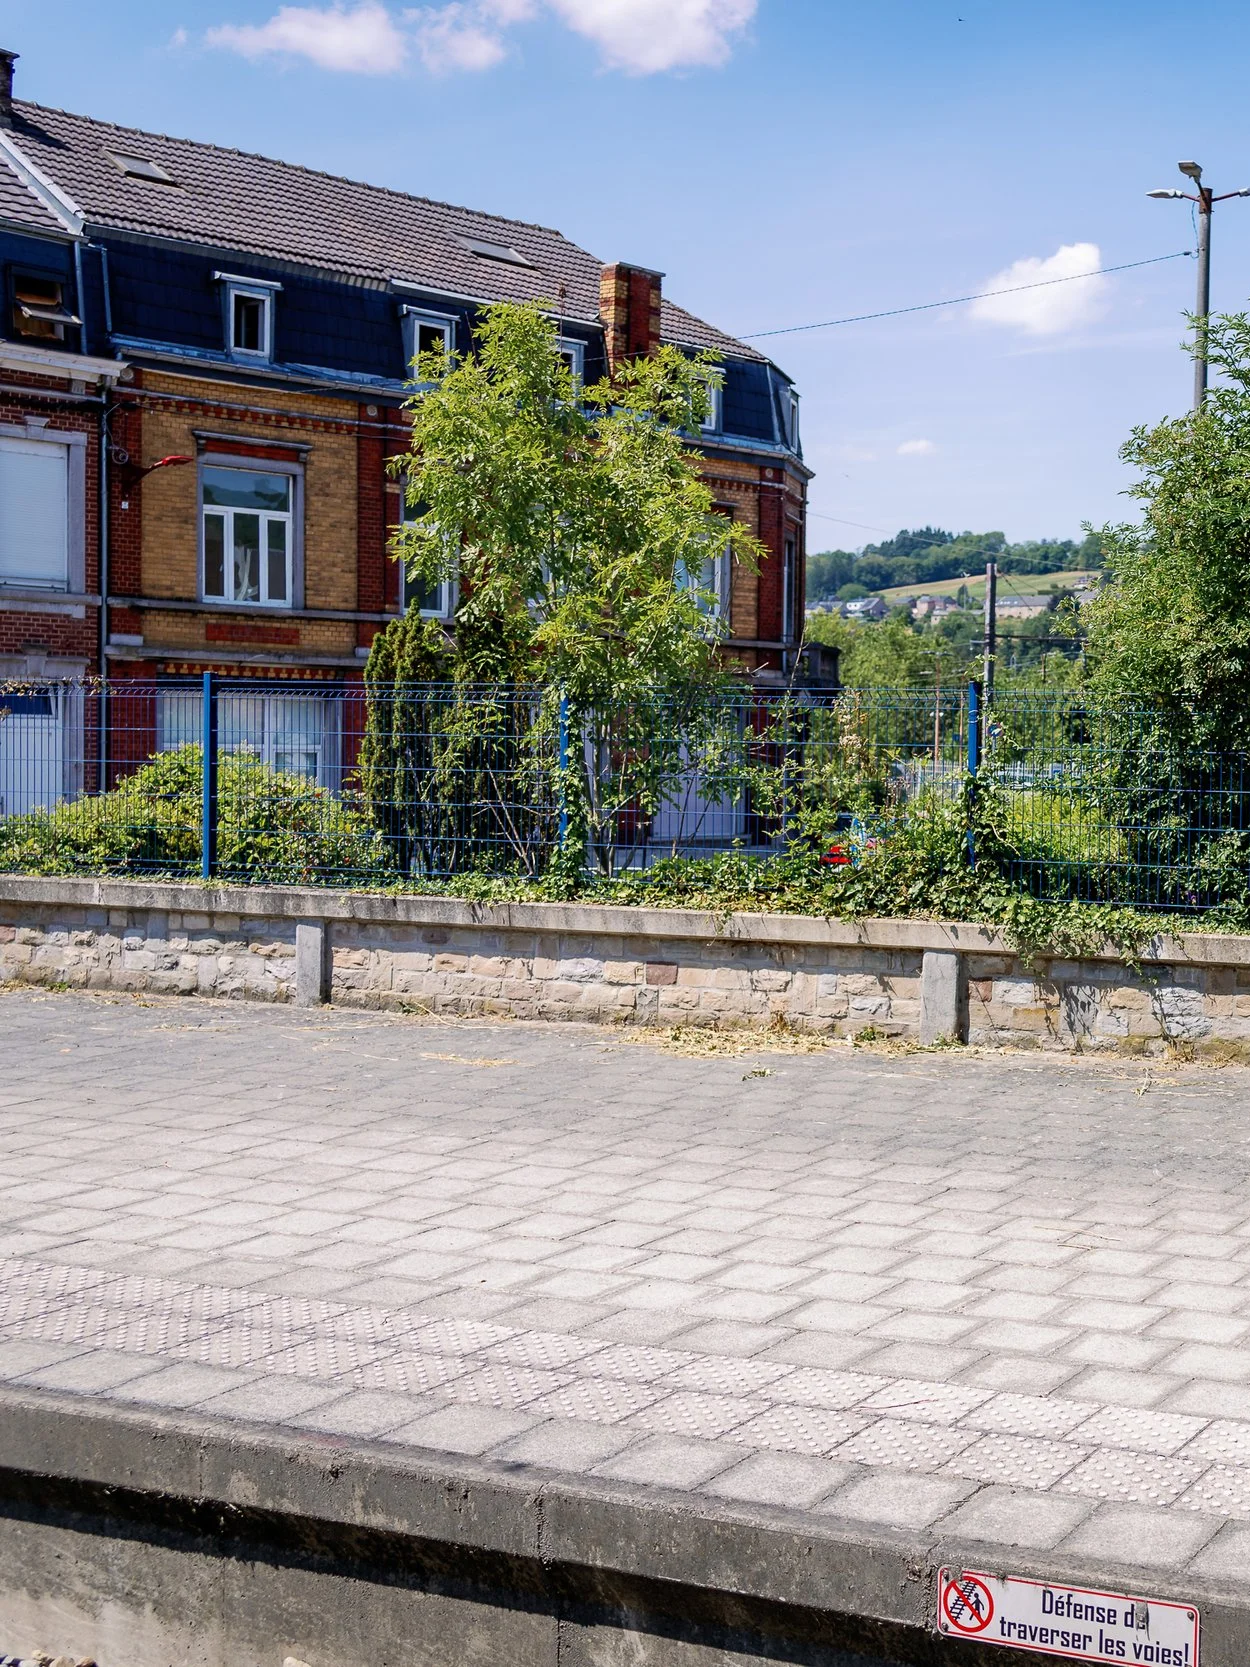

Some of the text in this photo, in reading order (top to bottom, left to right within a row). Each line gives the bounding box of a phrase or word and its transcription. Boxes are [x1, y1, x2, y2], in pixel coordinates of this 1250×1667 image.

[1041, 1589, 1117, 1626] Défense
[999, 1616, 1189, 1667] traverser les voies!
